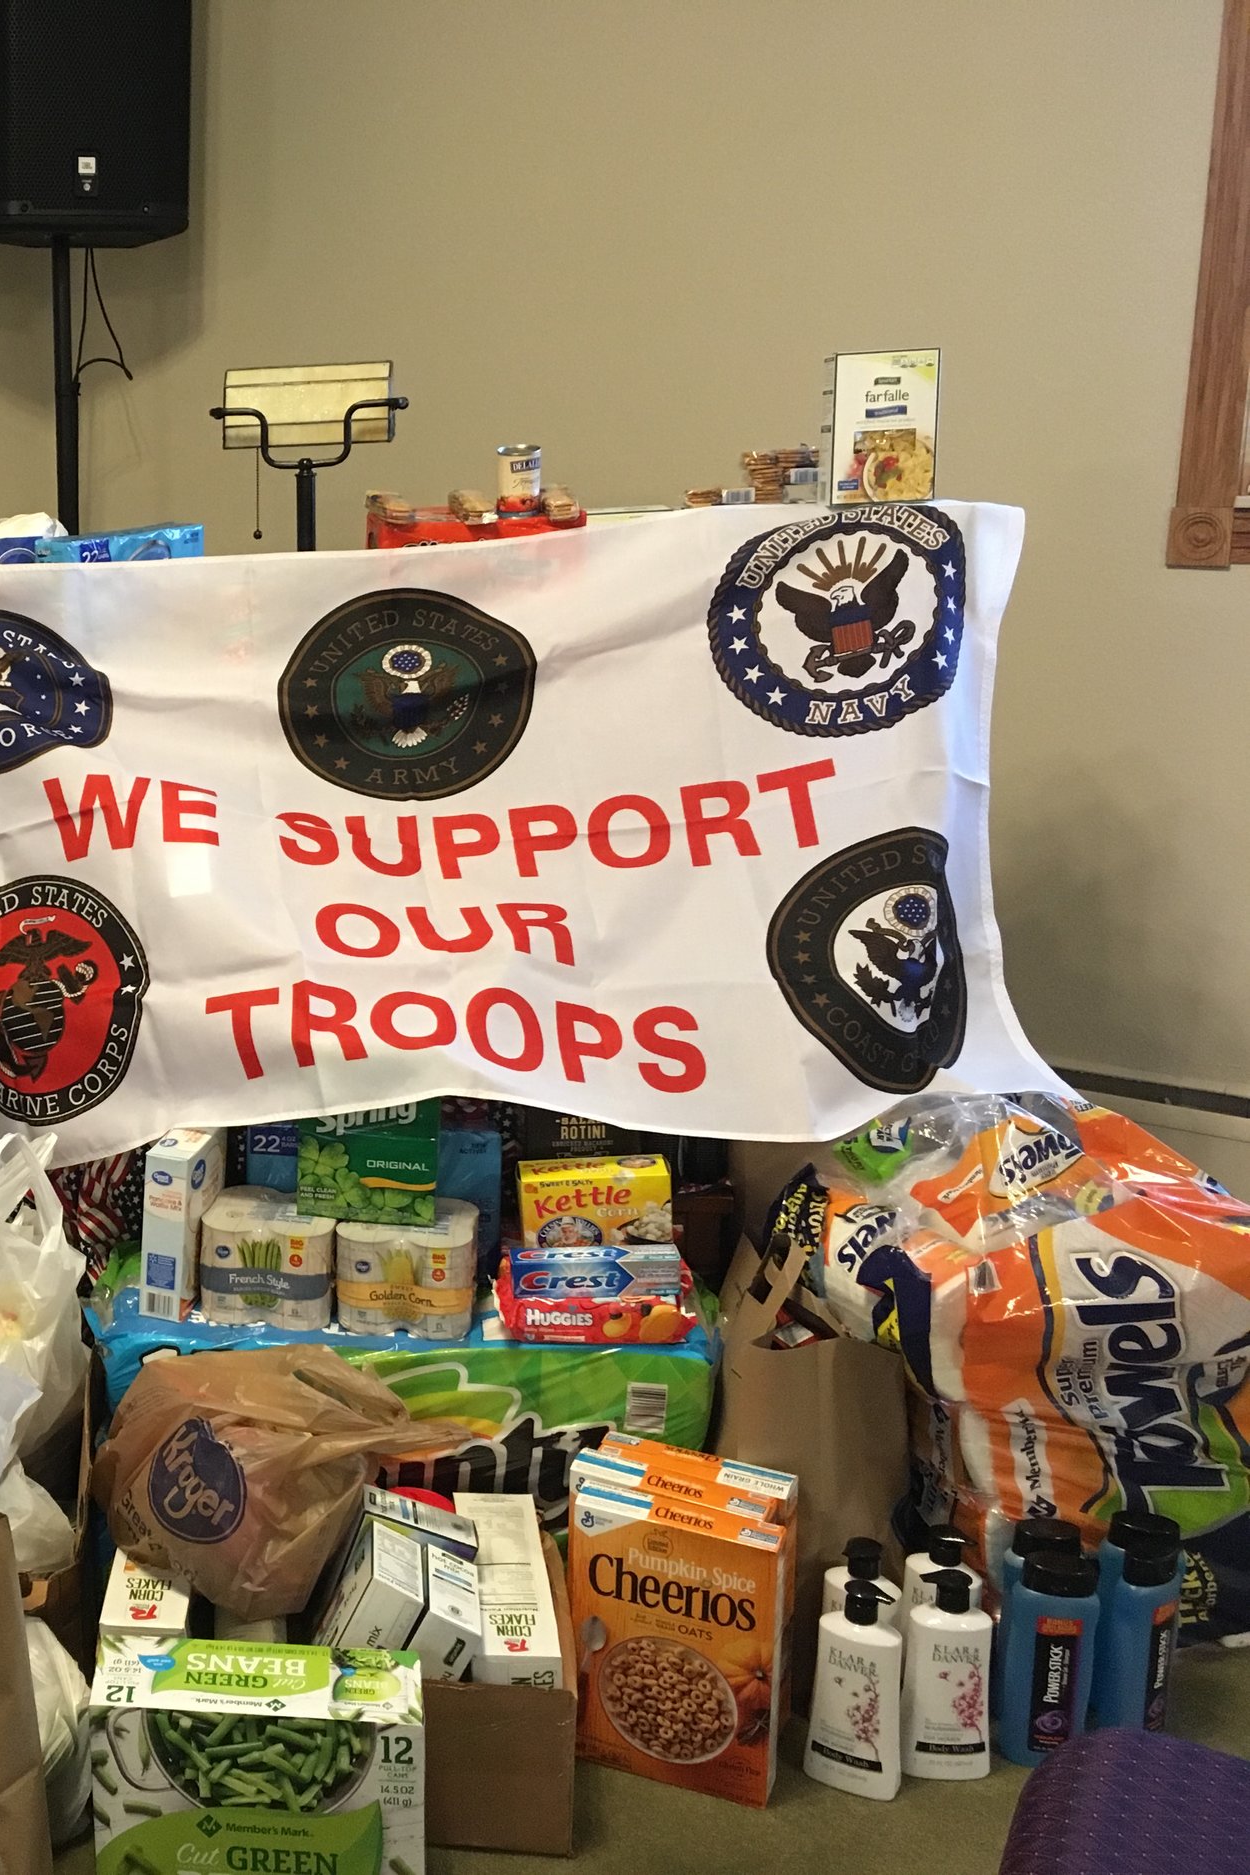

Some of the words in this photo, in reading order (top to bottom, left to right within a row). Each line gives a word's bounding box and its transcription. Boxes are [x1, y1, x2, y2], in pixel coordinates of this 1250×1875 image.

[865, 389, 910, 403] farfalle
[735, 511, 838, 589] UNITED
[842, 505, 950, 550] STATES
[310, 609, 400, 674] UNITED
[412, 608, 500, 651] STATES
[806, 675, 916, 725] NAVY
[366, 757, 460, 786] ARMY
[43, 774, 220, 863] WE
[274, 758, 836, 880] SUPPORT
[798, 850, 901, 926] UNITED
[31, 885, 108, 929] STATES
[315, 902, 576, 968] OUR
[206, 980, 707, 1095] TROOPS
[826, 1007, 895, 1071] COAST
[68, 1023, 129, 1107] CORPS
[316, 1102, 417, 1136] Spring
[561, 1124, 606, 1140] ROTINI
[253, 1135, 280, 1152] 22
[366, 1159, 430, 1172] ORIGINAL
[539, 1180, 564, 1188] SWEET
[534, 1185, 632, 1219] Kettle
[229, 1273, 265, 1284] French
[267, 1275, 290, 1290] Style
[521, 1270, 620, 1291] Crest
[369, 1290, 407, 1301] Golden
[409, 1293, 437, 1308] Corn
[526, 1308, 593, 1327] HUGGIES
[1075, 1255, 1227, 1513] Towels
[163, 1425, 235, 1526] Kroger
[647, 1473, 703, 1499] Cheerios
[655, 1506, 714, 1530] Cheerios
[628, 1547, 708, 1581] Pumpkin
[712, 1566, 757, 1594] Spice
[126, 1577, 172, 1590] FLAKES
[588, 1553, 757, 1632] Cheerios
[129, 1589, 164, 1601] CORN
[489, 1614, 536, 1626] FLAKES
[366, 1625, 383, 1646] mix
[496, 1625, 532, 1637] CORN
[678, 1623, 713, 1641] OATS
[829, 1646, 865, 1667] KLAR
[932, 1652, 981, 1664] DANVER
[934, 1643, 969, 1655] KLAR
[187, 1653, 307, 1677] BEANS
[828, 1655, 878, 1678] DANVER
[184, 1671, 268, 1689] GREEN
[106, 1685, 136, 1703] 12
[345, 1687, 376, 1695] GREEN
[223, 1699, 263, 1707] Member's
[380, 1736, 414, 1765] 12
[387, 1771, 409, 1779] CANS
[401, 1785, 415, 1795] OZ
[383, 1796, 401, 1807] (411
[225, 1822, 280, 1837] Member's
[281, 1826, 311, 1838] Mark
[176, 1842, 220, 1866] Cut
[226, 1845, 339, 1875] GREEN
